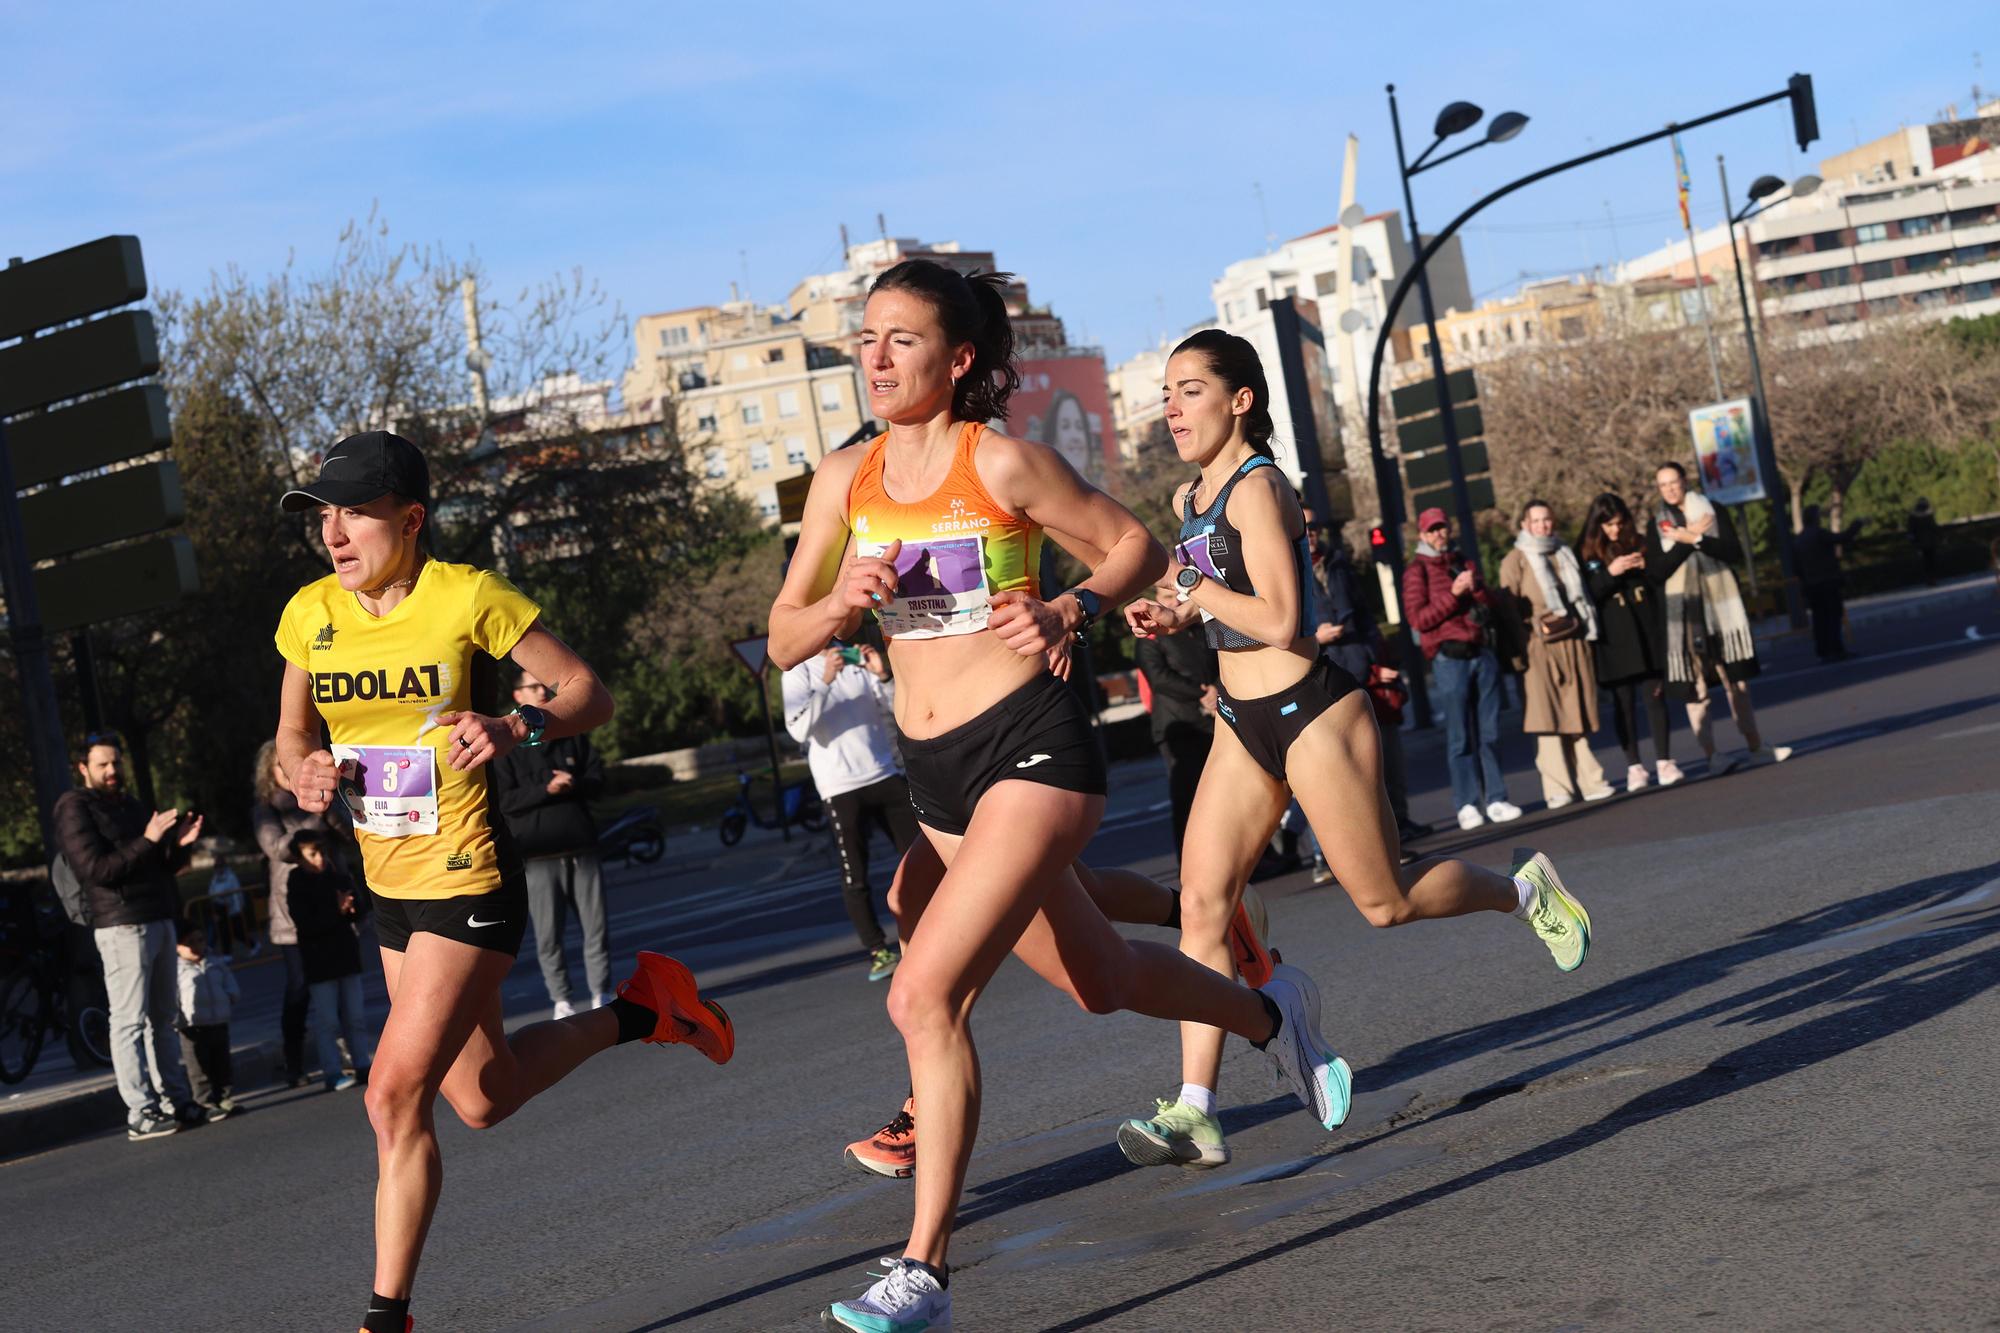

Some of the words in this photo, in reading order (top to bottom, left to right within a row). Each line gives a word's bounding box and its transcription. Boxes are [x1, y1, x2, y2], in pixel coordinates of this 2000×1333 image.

[931, 517, 991, 533] SERRANO
[382, 761, 398, 792] 3
[374, 800, 388, 810] ELIA
